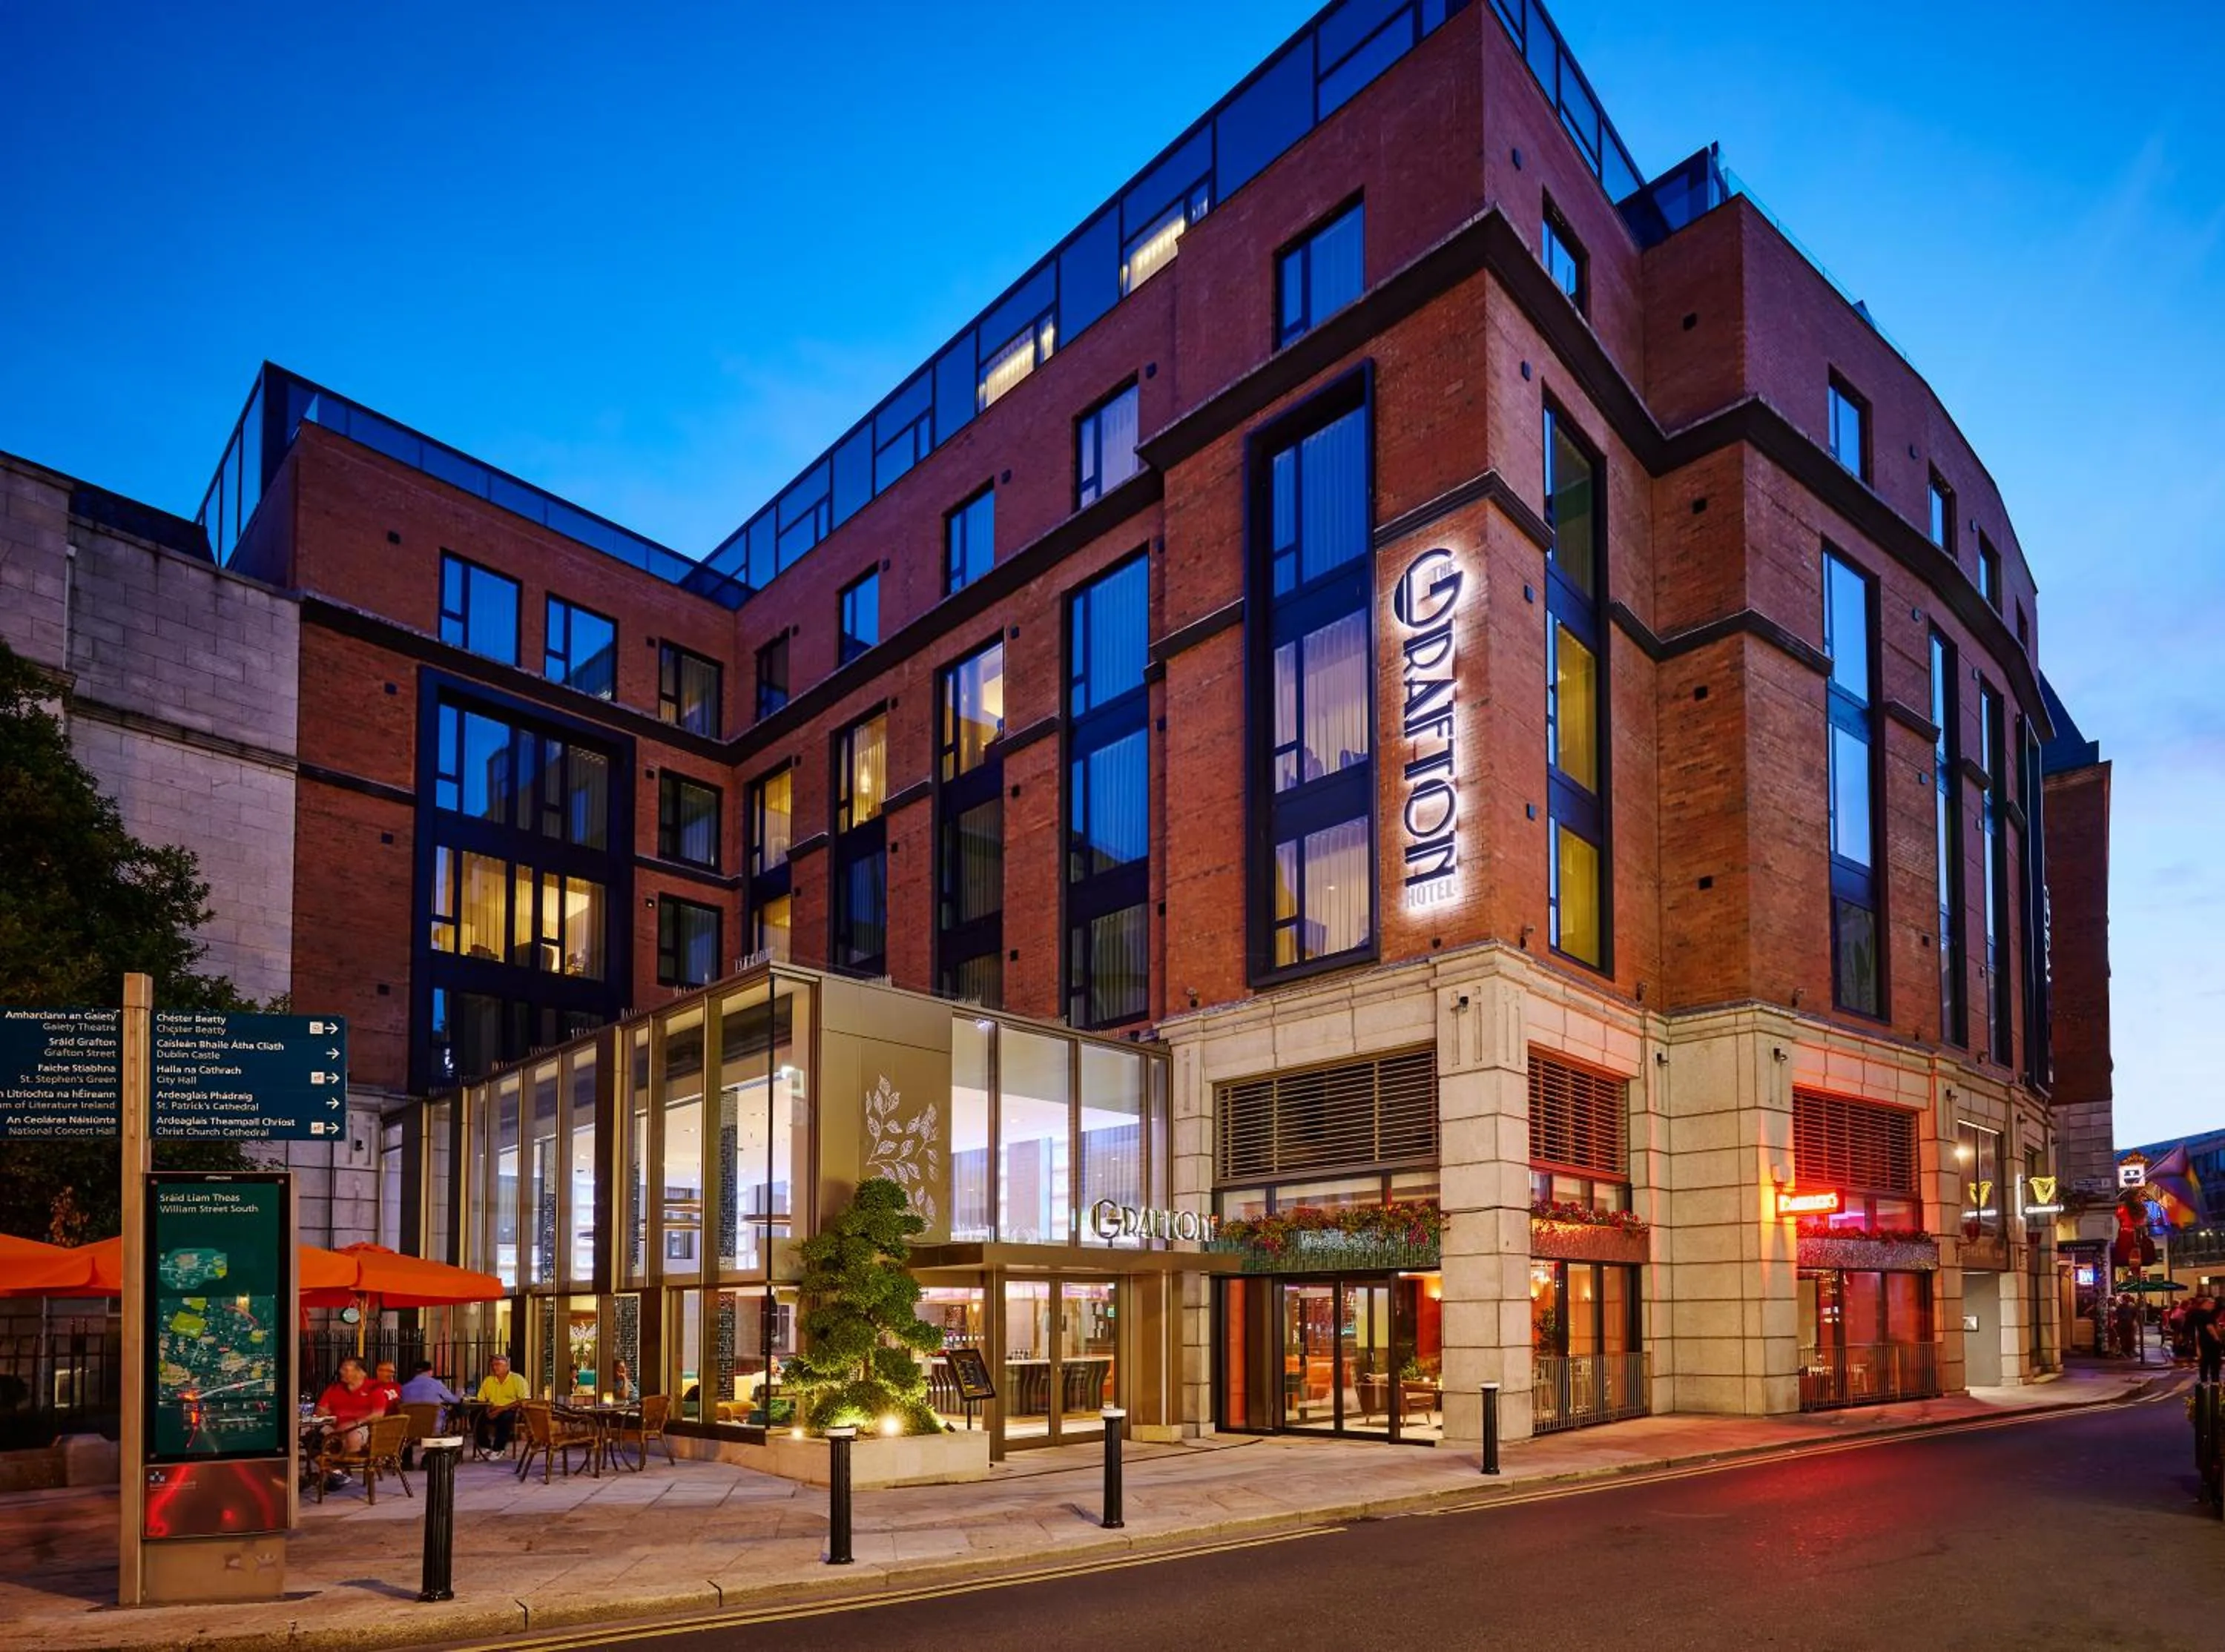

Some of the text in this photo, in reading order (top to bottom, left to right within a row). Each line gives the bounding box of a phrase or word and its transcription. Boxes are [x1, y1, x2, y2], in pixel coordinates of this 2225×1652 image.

[1394, 548, 1464, 888] GRAFTON
[1405, 878, 1455, 908] HOTEL
[84, 1012, 116, 1021] Gaiety
[156, 1014, 226, 1025] Chester Beatty
[43, 1022, 116, 1032] Gaiety Theatre
[156, 1024, 226, 1035] Chester Beatty
[77, 1037, 116, 1046] Grafton
[200, 1040, 228, 1049] Bhaile
[257, 1042, 284, 1051] Cliath
[44, 1048, 116, 1057] Grafton Street
[156, 1050, 220, 1060] Dublin Castle
[199, 1065, 242, 1074] Cathrach
[86, 1075, 116, 1083] Green
[156, 1076, 176, 1085] City
[156, 1091, 208, 1100] Ardeaglais
[14, 1100, 26, 1109] of
[81, 1101, 116, 1109] Ireland
[213, 1103, 259, 1111] Cathedral
[6, 1116, 22, 1124] An
[156, 1117, 208, 1126] Ardeaglais
[9, 1126, 116, 1135] National Concert Hall
[186, 1128, 220, 1136] Church
[187, 1194, 210, 1202] Liam
[211, 1193, 240, 1202] Theas
[159, 1204, 259, 1214] William Street South
